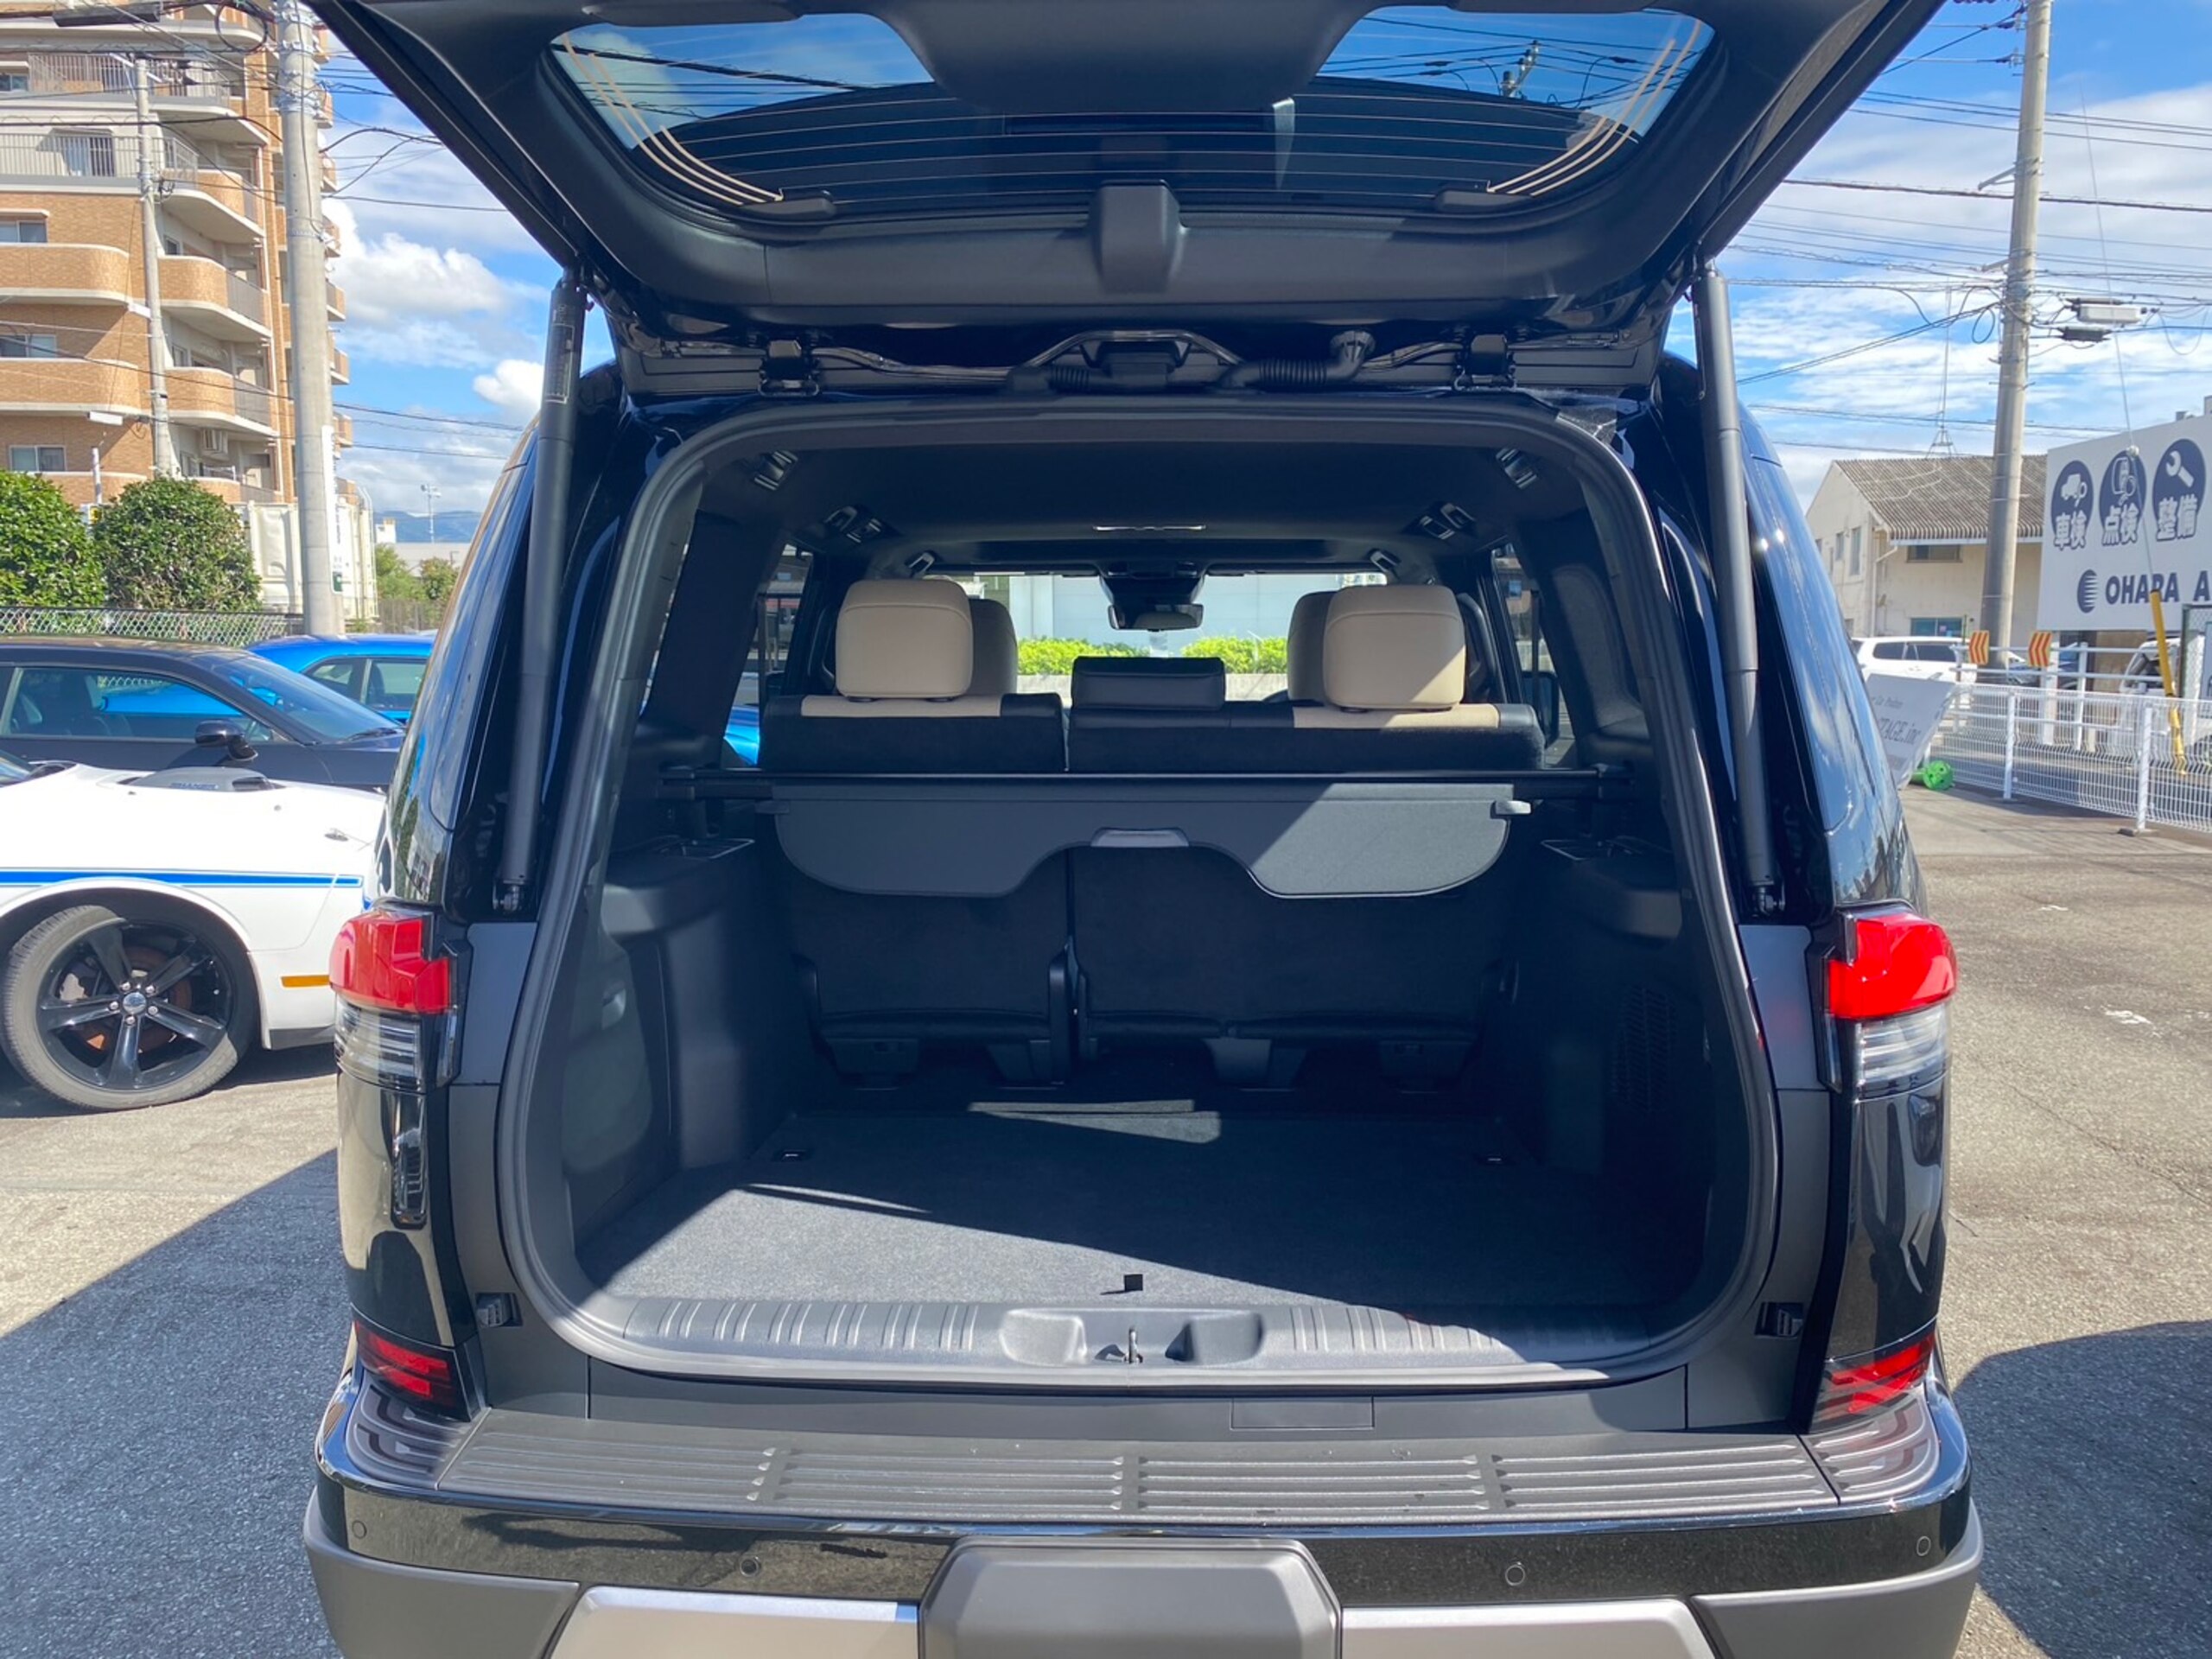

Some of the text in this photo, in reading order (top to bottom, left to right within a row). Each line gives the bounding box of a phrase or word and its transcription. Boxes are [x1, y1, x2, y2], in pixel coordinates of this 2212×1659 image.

[2054, 510, 2088, 551] 車検
[2102, 503, 2139, 546] 点検
[2157, 493, 2198, 542] 整備
[2105, 572, 2180, 605] OHARA
